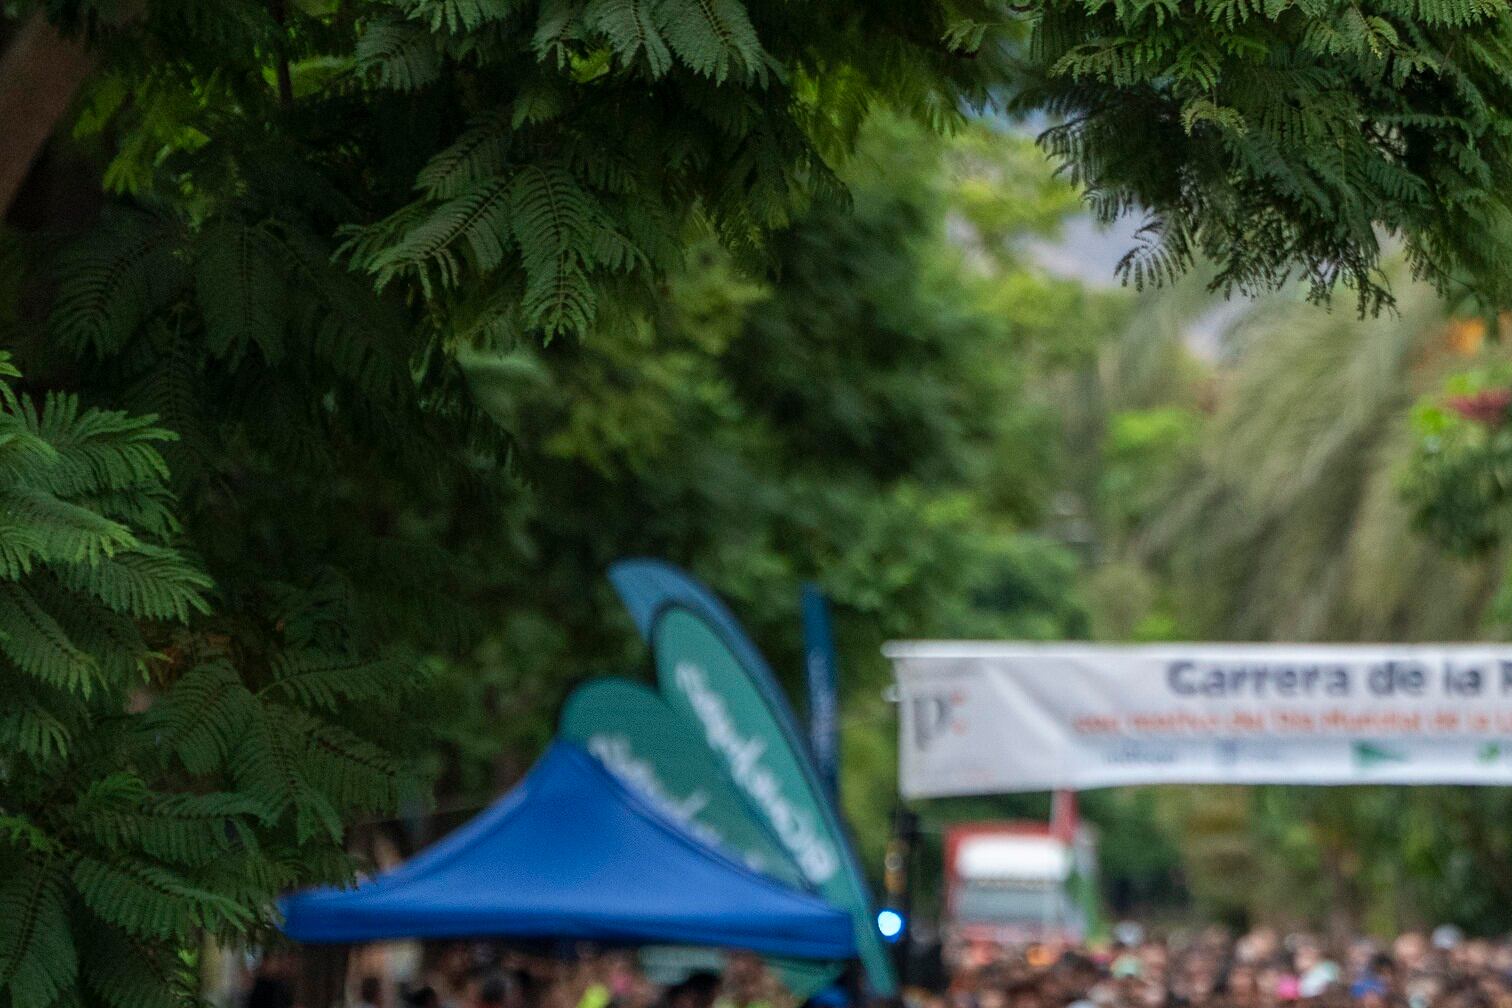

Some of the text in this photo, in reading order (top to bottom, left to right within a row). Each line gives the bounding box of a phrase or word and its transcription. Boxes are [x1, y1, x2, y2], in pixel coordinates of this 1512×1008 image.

[1167, 661, 1348, 696] Carrera
[1366, 661, 1425, 696] de
[1445, 661, 1482, 696] la
